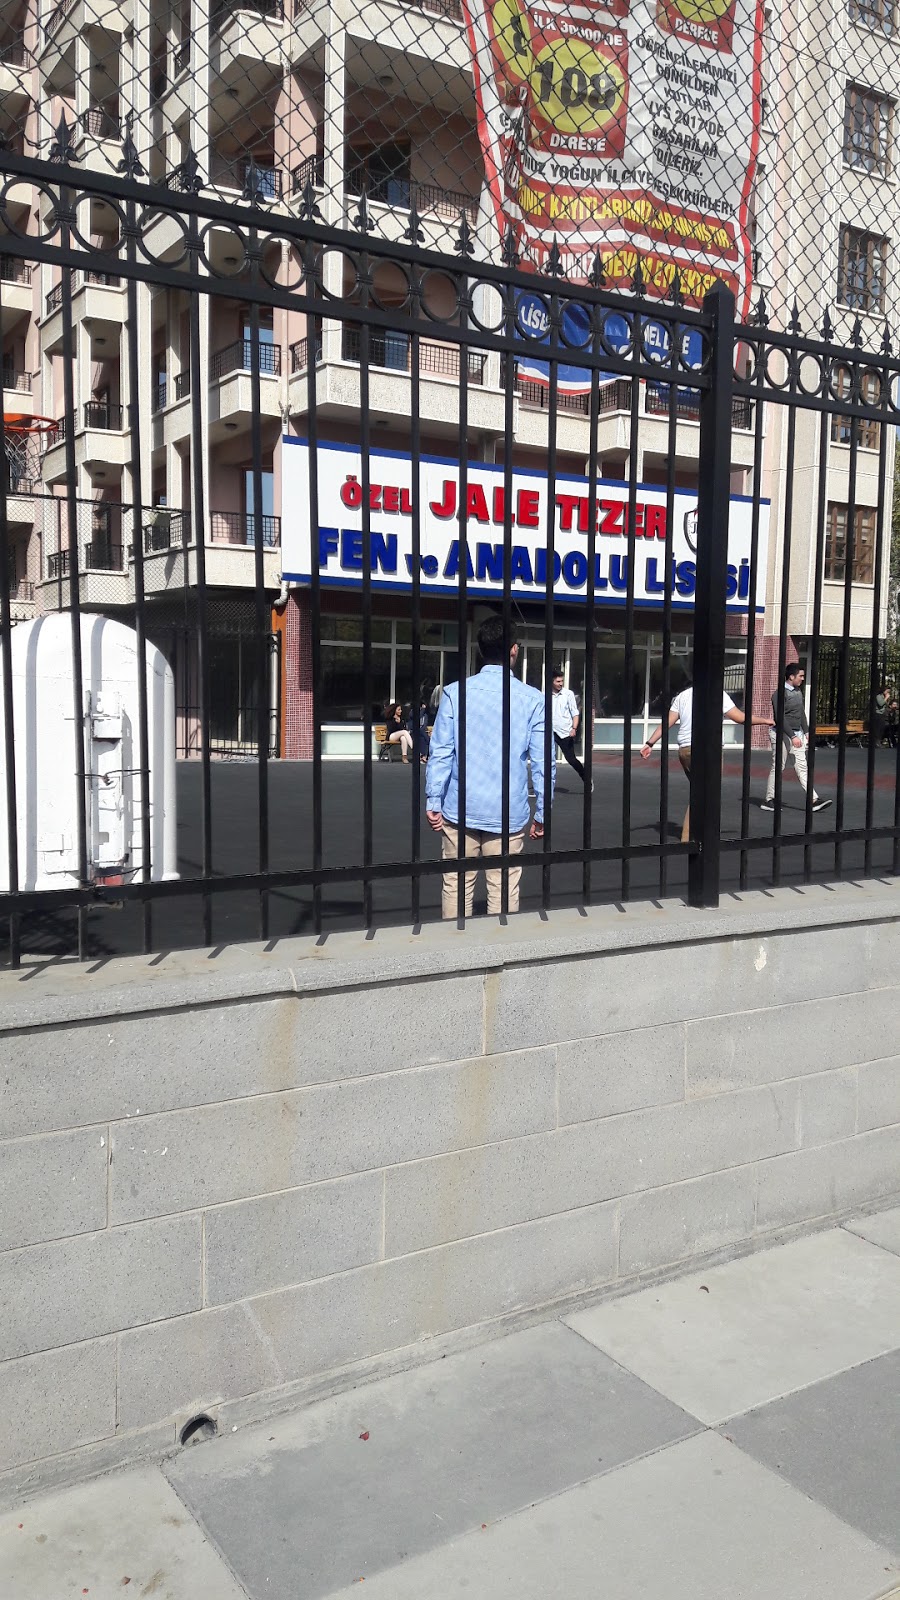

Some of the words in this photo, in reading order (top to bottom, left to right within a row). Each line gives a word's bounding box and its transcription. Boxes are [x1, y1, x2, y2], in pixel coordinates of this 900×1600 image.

[533, 11, 556, 31] İLK
[675, 18, 719, 45] DERECE
[534, 60, 616, 110] 108
[656, 63, 718, 97] GÖNÜLDEN
[648, 100, 672, 120] LYS
[549, 132, 606, 152] DERECE
[550, 163, 602, 183] YOĞUN
[341, 474, 413, 513] ÖZEL
[429, 480, 539, 527] JALE
[557, 493, 667, 540] TEZER
[318, 526, 398, 572] FEN
[405, 553, 439, 576] ve
[445, 541, 627, 590] ANADOLU
[646, 552, 750, 600] LİSSİ
